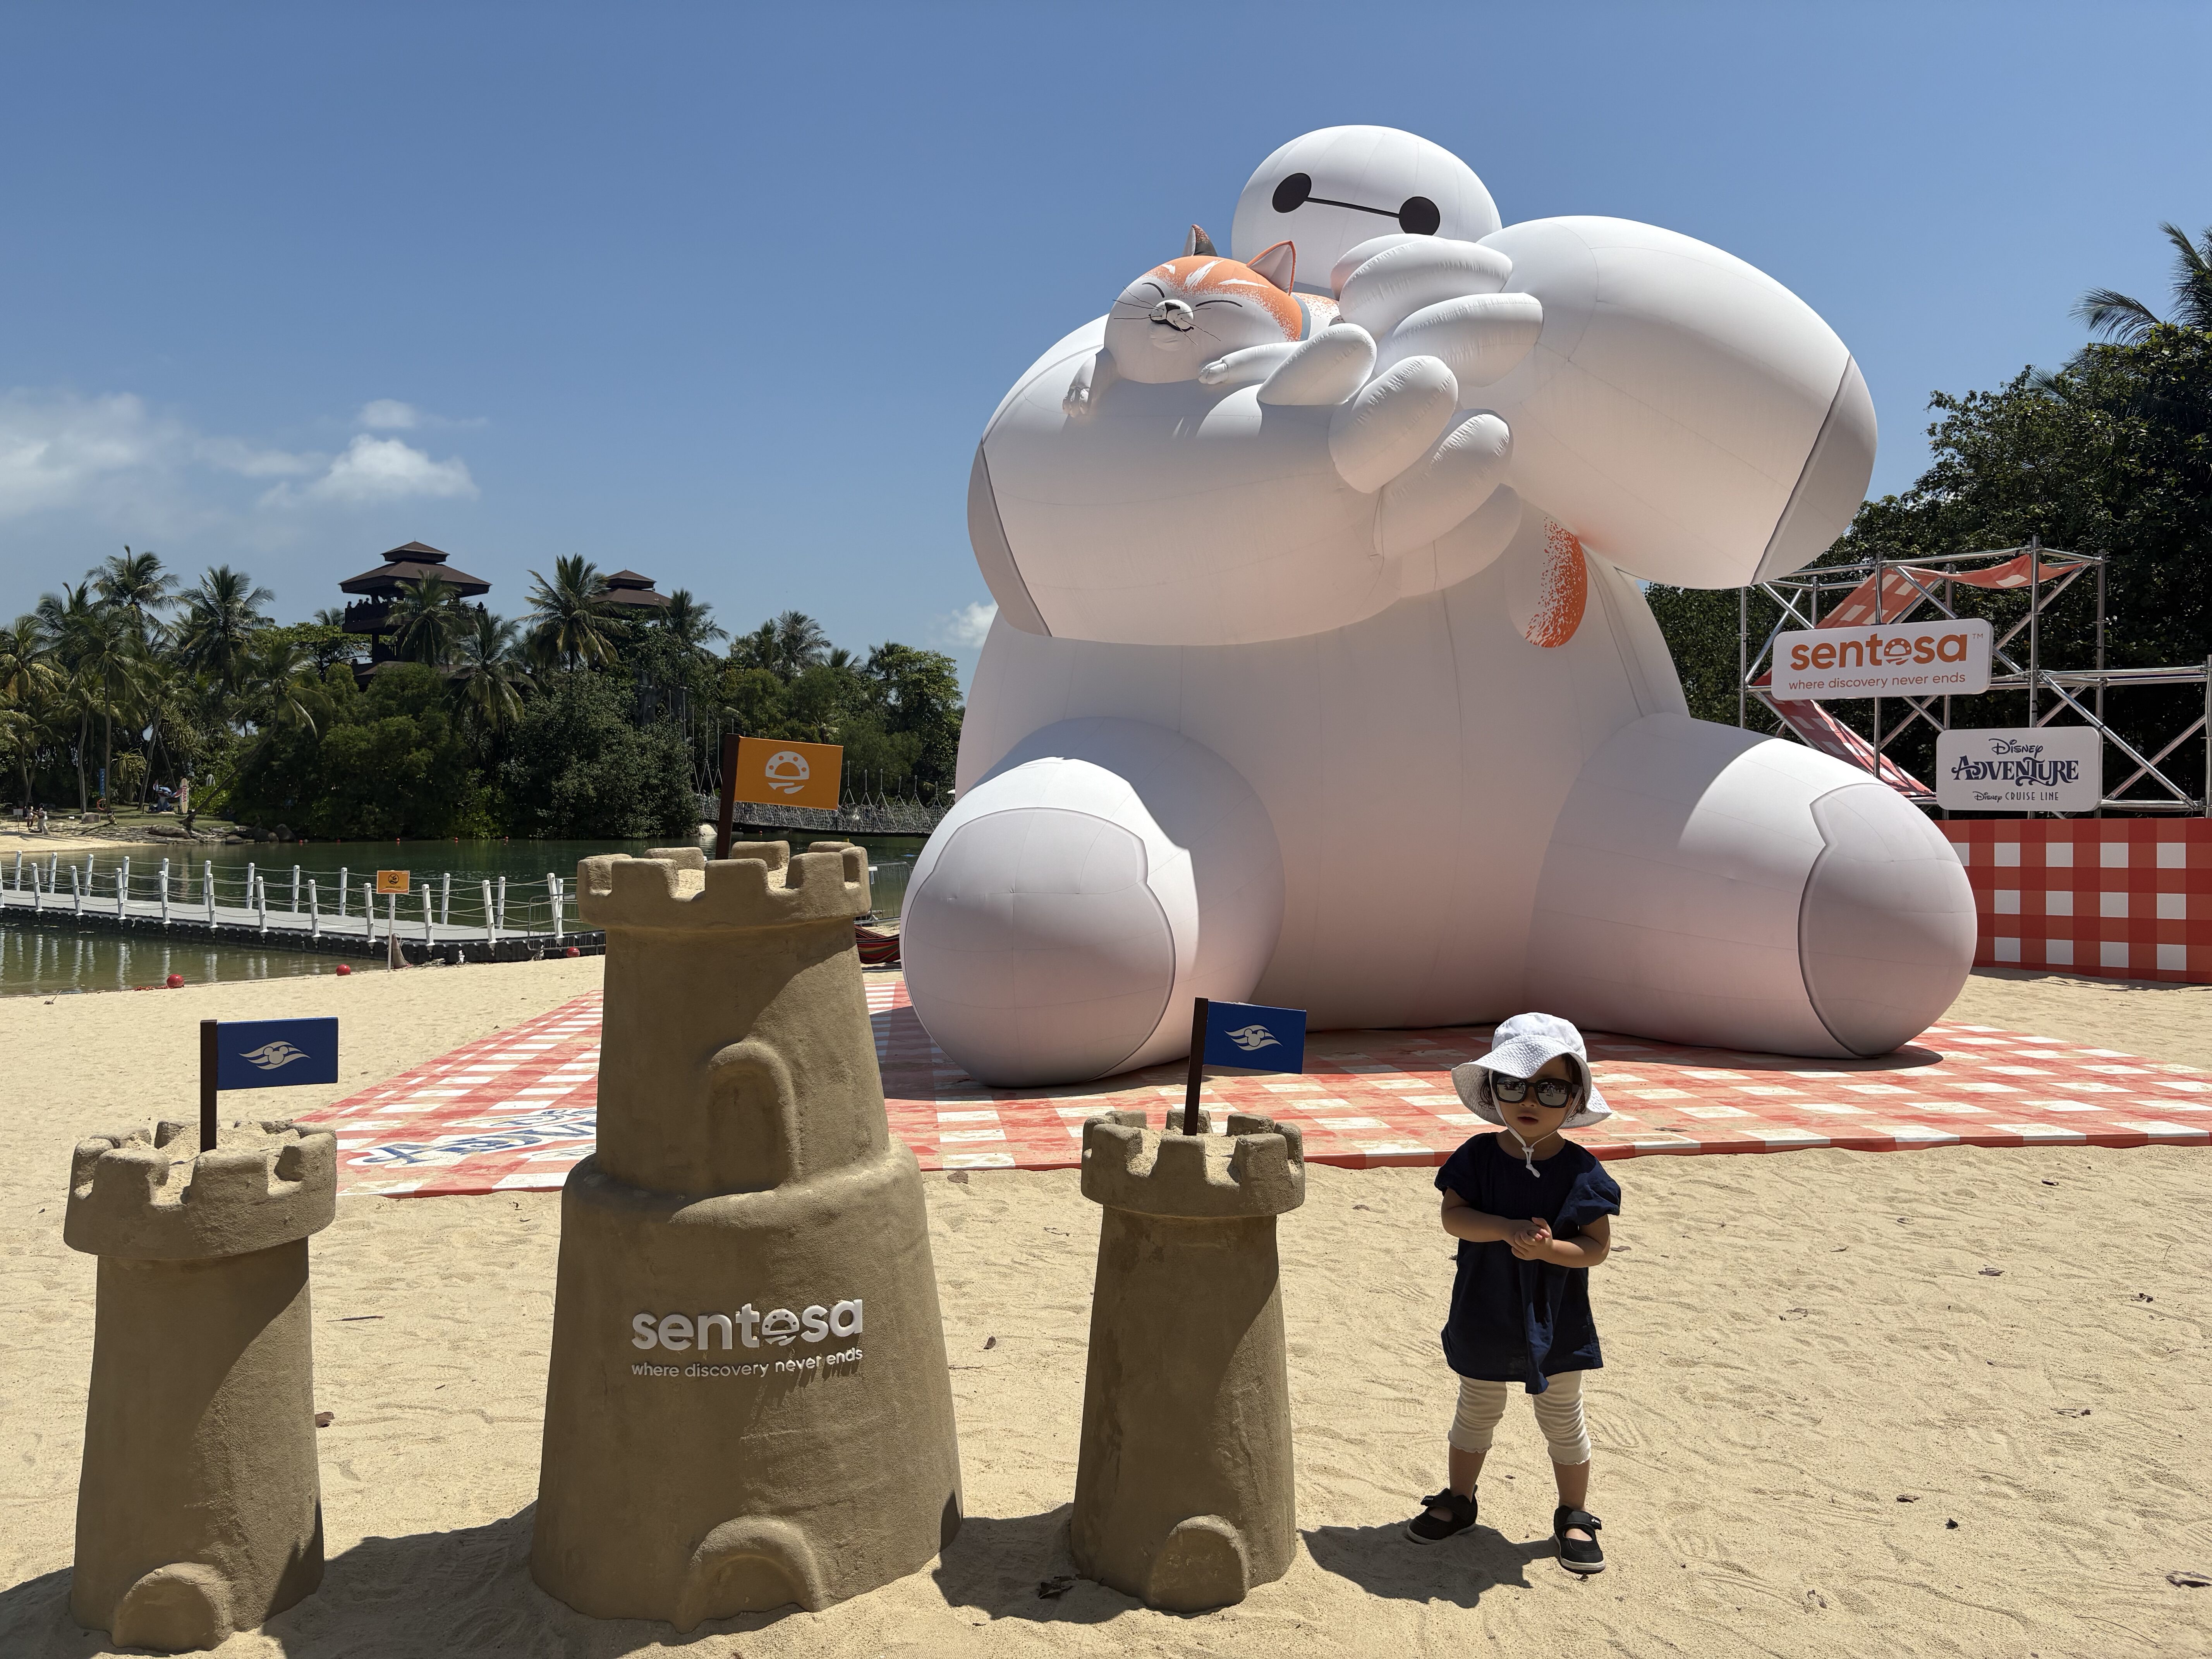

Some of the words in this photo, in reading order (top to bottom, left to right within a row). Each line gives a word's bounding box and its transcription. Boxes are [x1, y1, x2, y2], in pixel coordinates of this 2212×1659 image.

[1790, 633, 1967, 670] sentosa
[1789, 679, 1824, 690] where
[1828, 677, 1888, 689] discovery
[1892, 675, 1929, 686] never
[1932, 672, 1966, 684] ends
[1988, 738, 2043, 758] Disney
[1951, 755, 2079, 787] ADVENTURE
[1972, 791, 2002, 803] Disney
[2005, 792, 2035, 801] CRUISE
[2040, 792, 2059, 801] LINE
[631, 1298, 863, 1351] sentosa
[631, 1362, 680, 1377] where
[684, 1362, 769, 1377] discovery
[775, 1355, 822, 1372] never
[826, 1348, 863, 1365] ends
